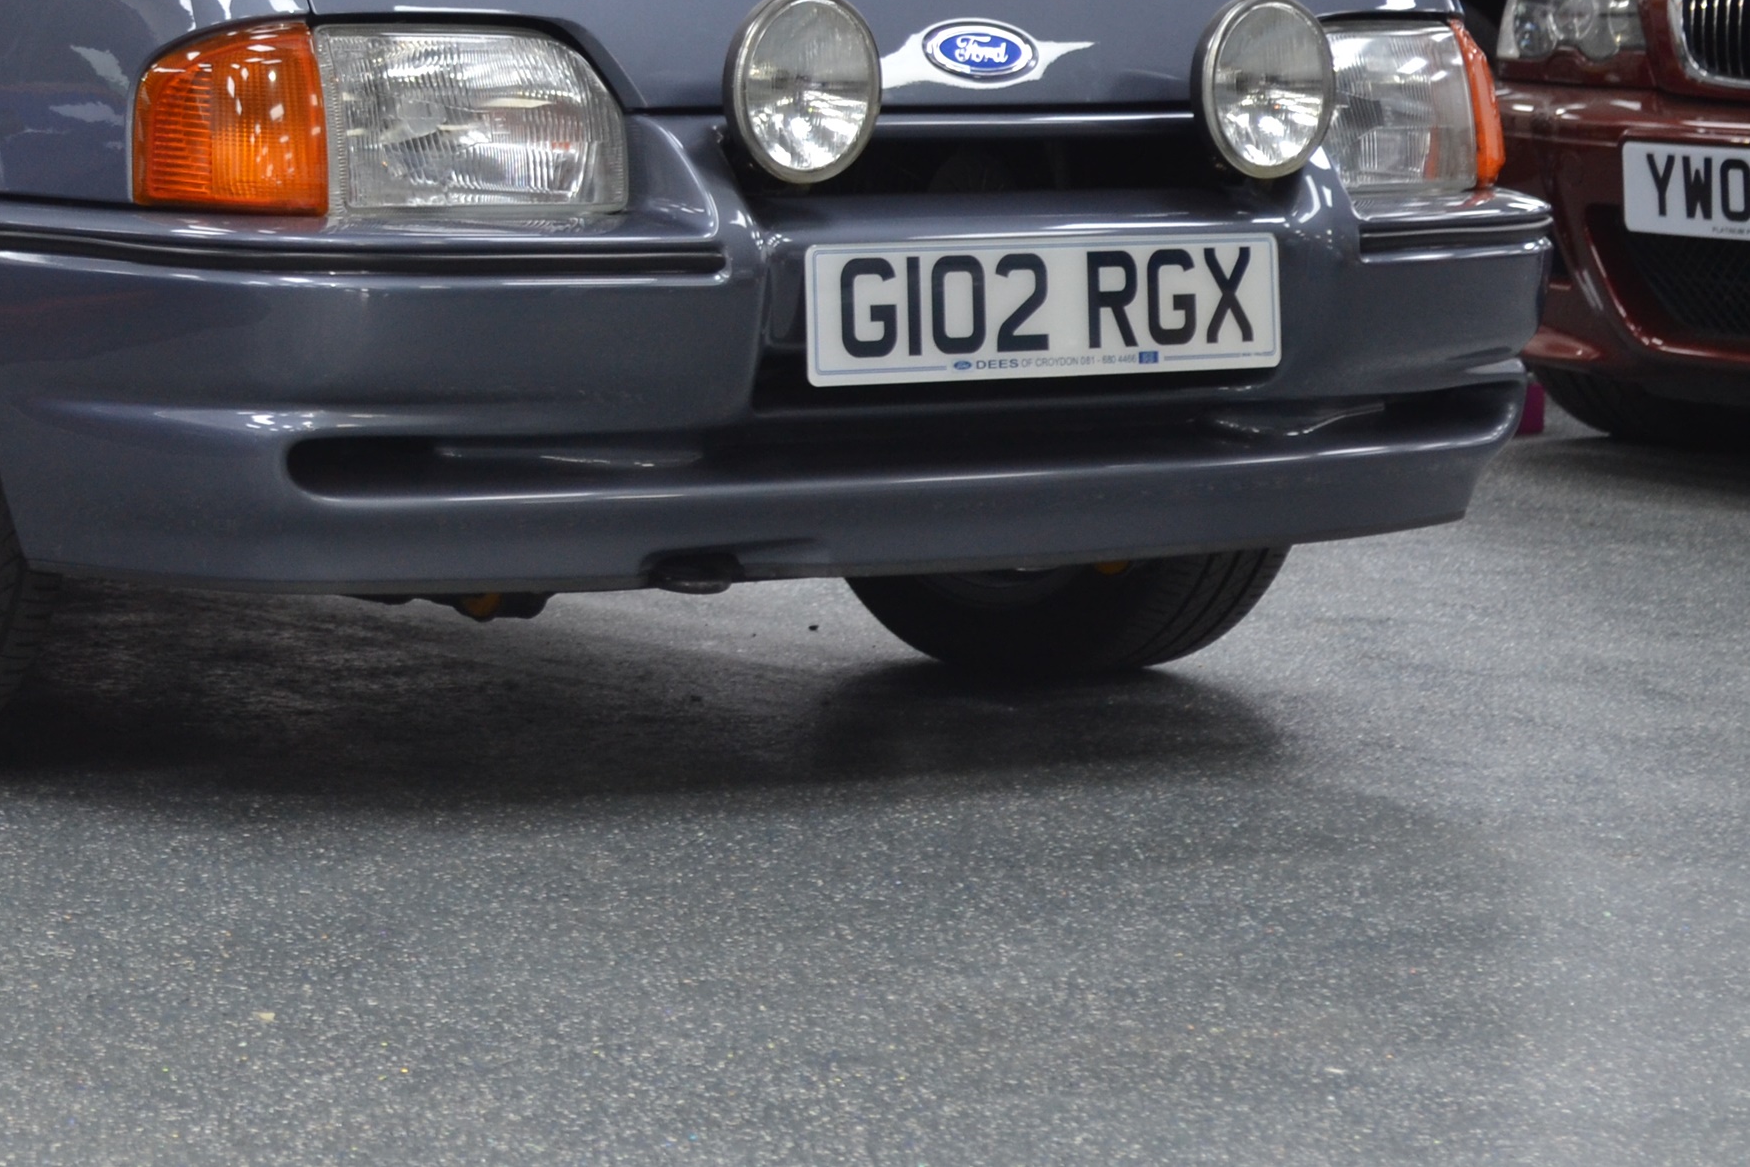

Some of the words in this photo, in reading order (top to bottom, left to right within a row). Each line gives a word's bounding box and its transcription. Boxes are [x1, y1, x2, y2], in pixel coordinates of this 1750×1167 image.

[954, 35, 1009, 64] Ford
[840, 252, 1050, 358] G102
[1087, 246, 1255, 349] RGX
[975, 357, 1019, 370] DEES
[1021, 357, 1033, 368] OF
[1035, 355, 1079, 367] CROYDON
